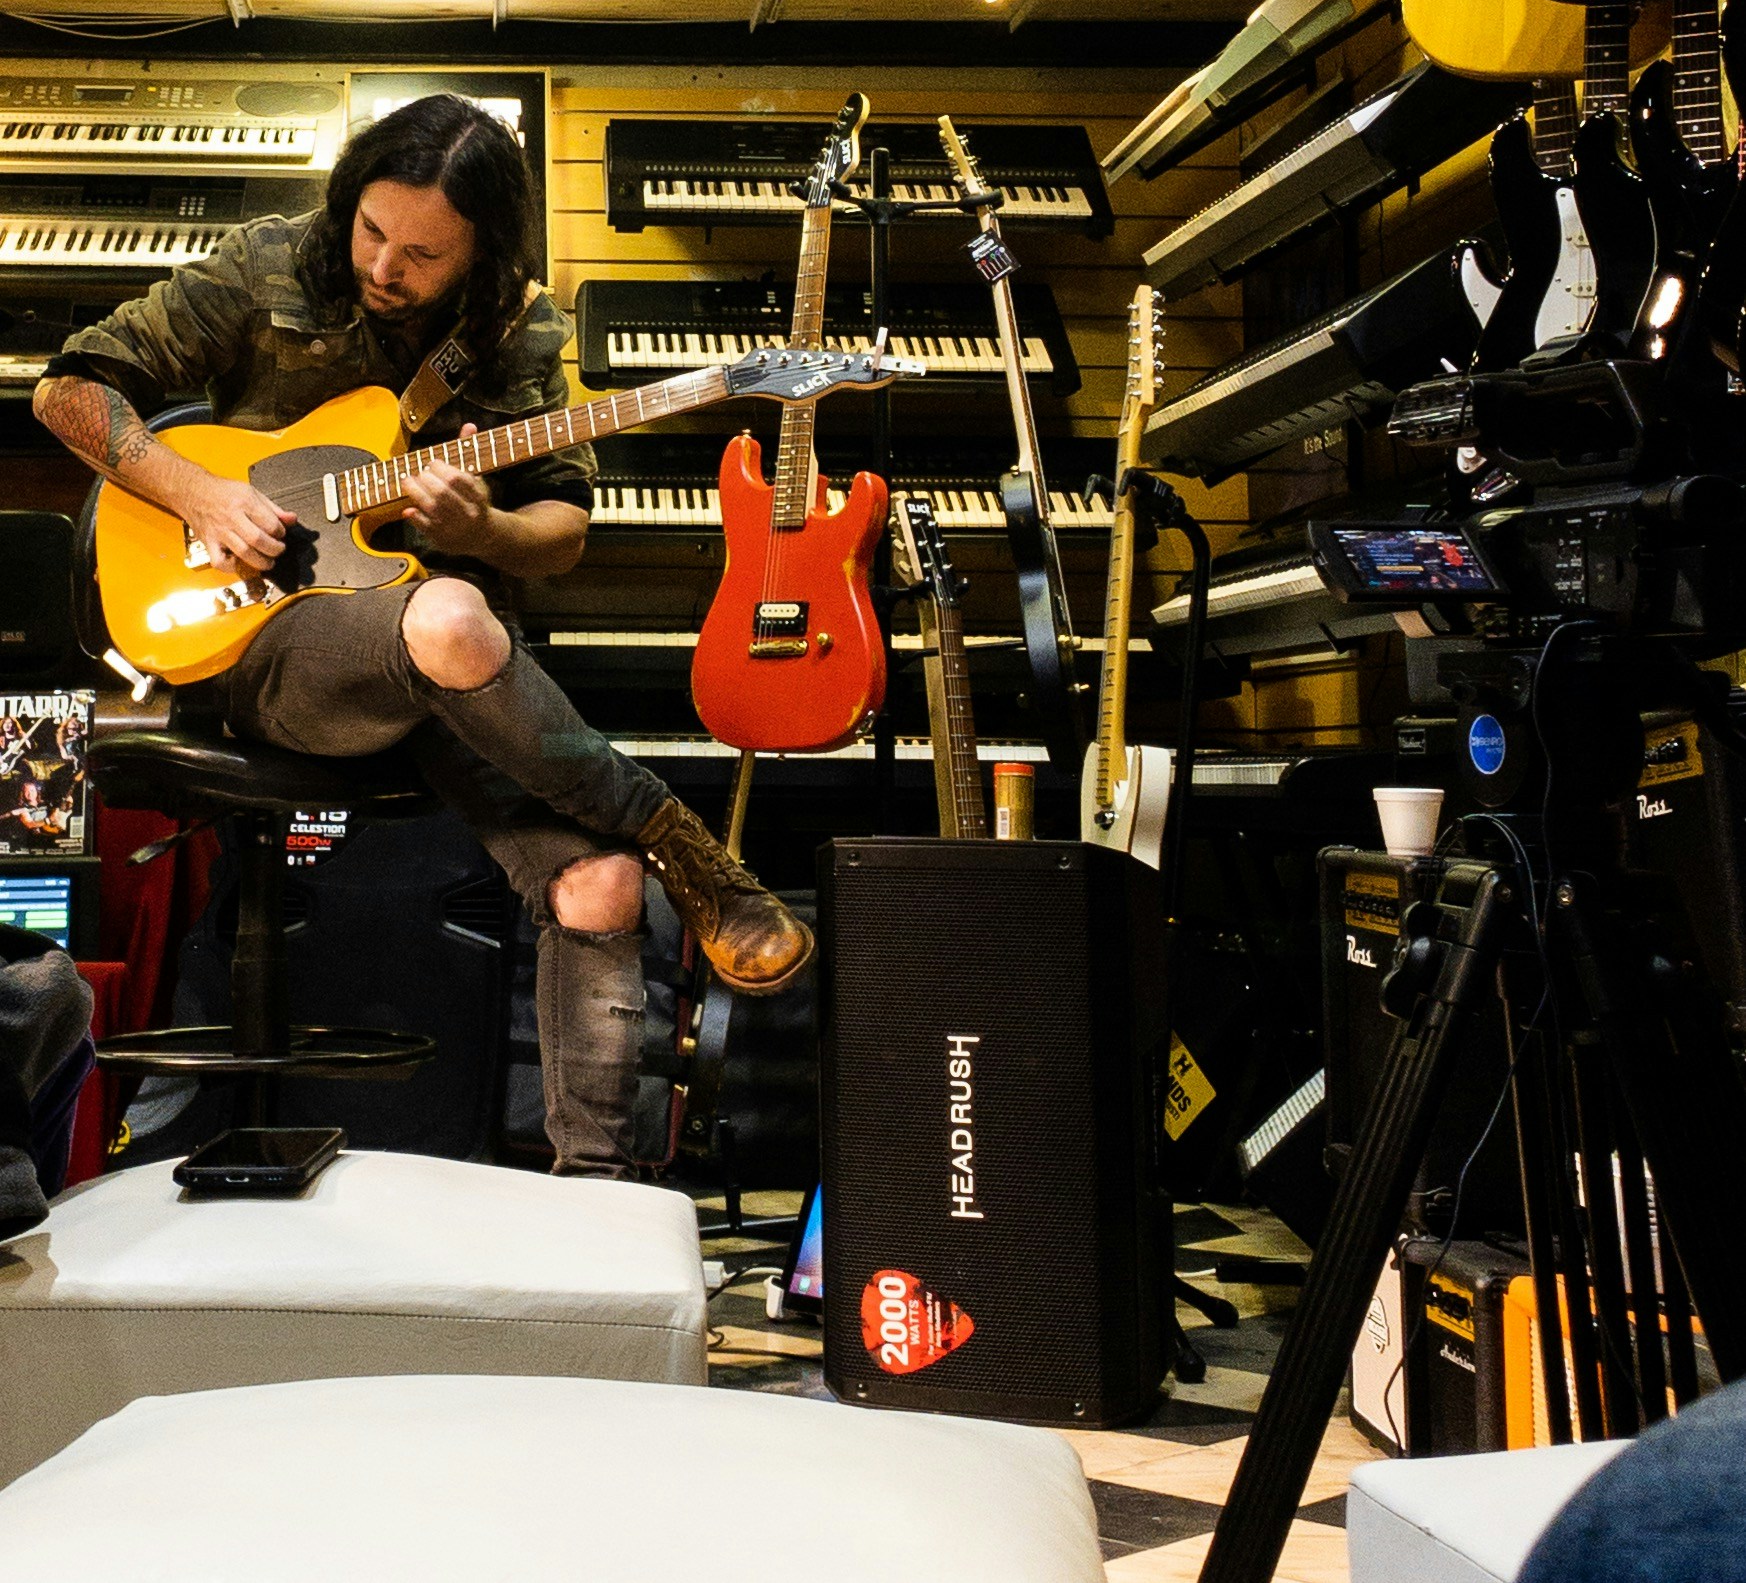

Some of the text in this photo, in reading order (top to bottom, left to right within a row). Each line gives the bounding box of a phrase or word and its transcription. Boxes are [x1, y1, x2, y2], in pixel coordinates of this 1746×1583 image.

[792, 369, 832, 398] SLICK
[1637, 795, 1673, 819] Ross
[290, 823, 346, 834] CELESTION
[1346, 935, 1377, 968] Ross
[947, 1035, 984, 1219] HEADRUSH
[878, 1276, 908, 1366] 2000
[908, 1299, 920, 1346] WATTS
